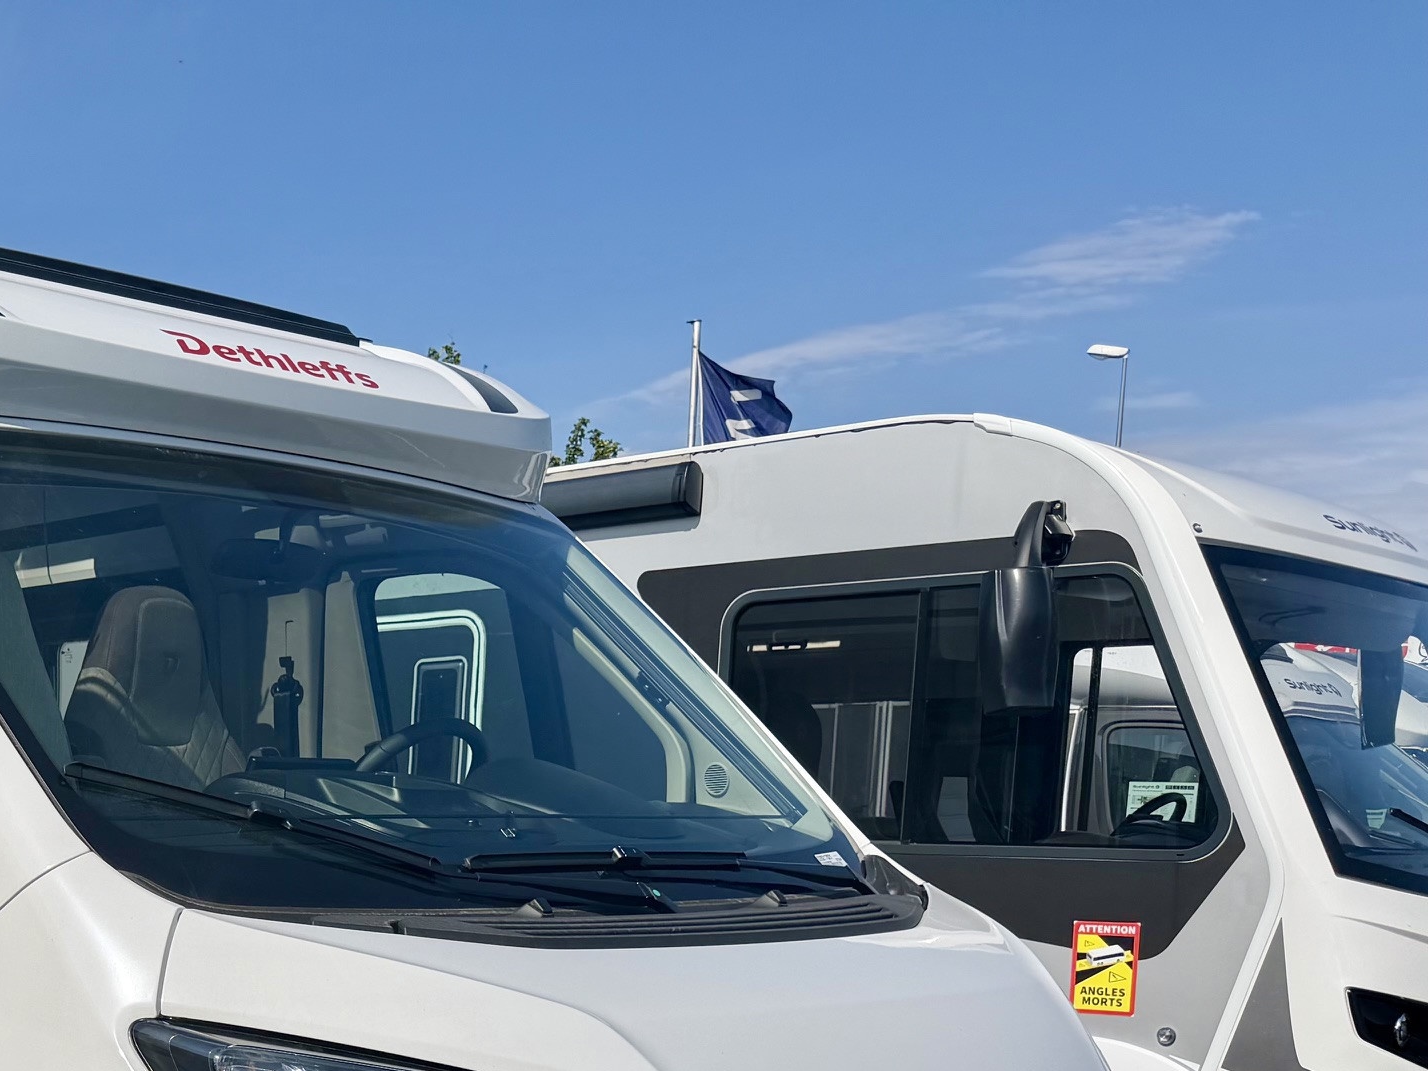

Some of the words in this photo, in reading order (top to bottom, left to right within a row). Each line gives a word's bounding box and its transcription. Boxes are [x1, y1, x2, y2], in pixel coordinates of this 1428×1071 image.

[159, 328, 380, 389] Dethleffs
[1283, 678, 1329, 695] Sunlight
[1077, 924, 1136, 935] ATTENTION
[1079, 986, 1126, 997] ANGLES
[1082, 997, 1123, 1007] MORTS
